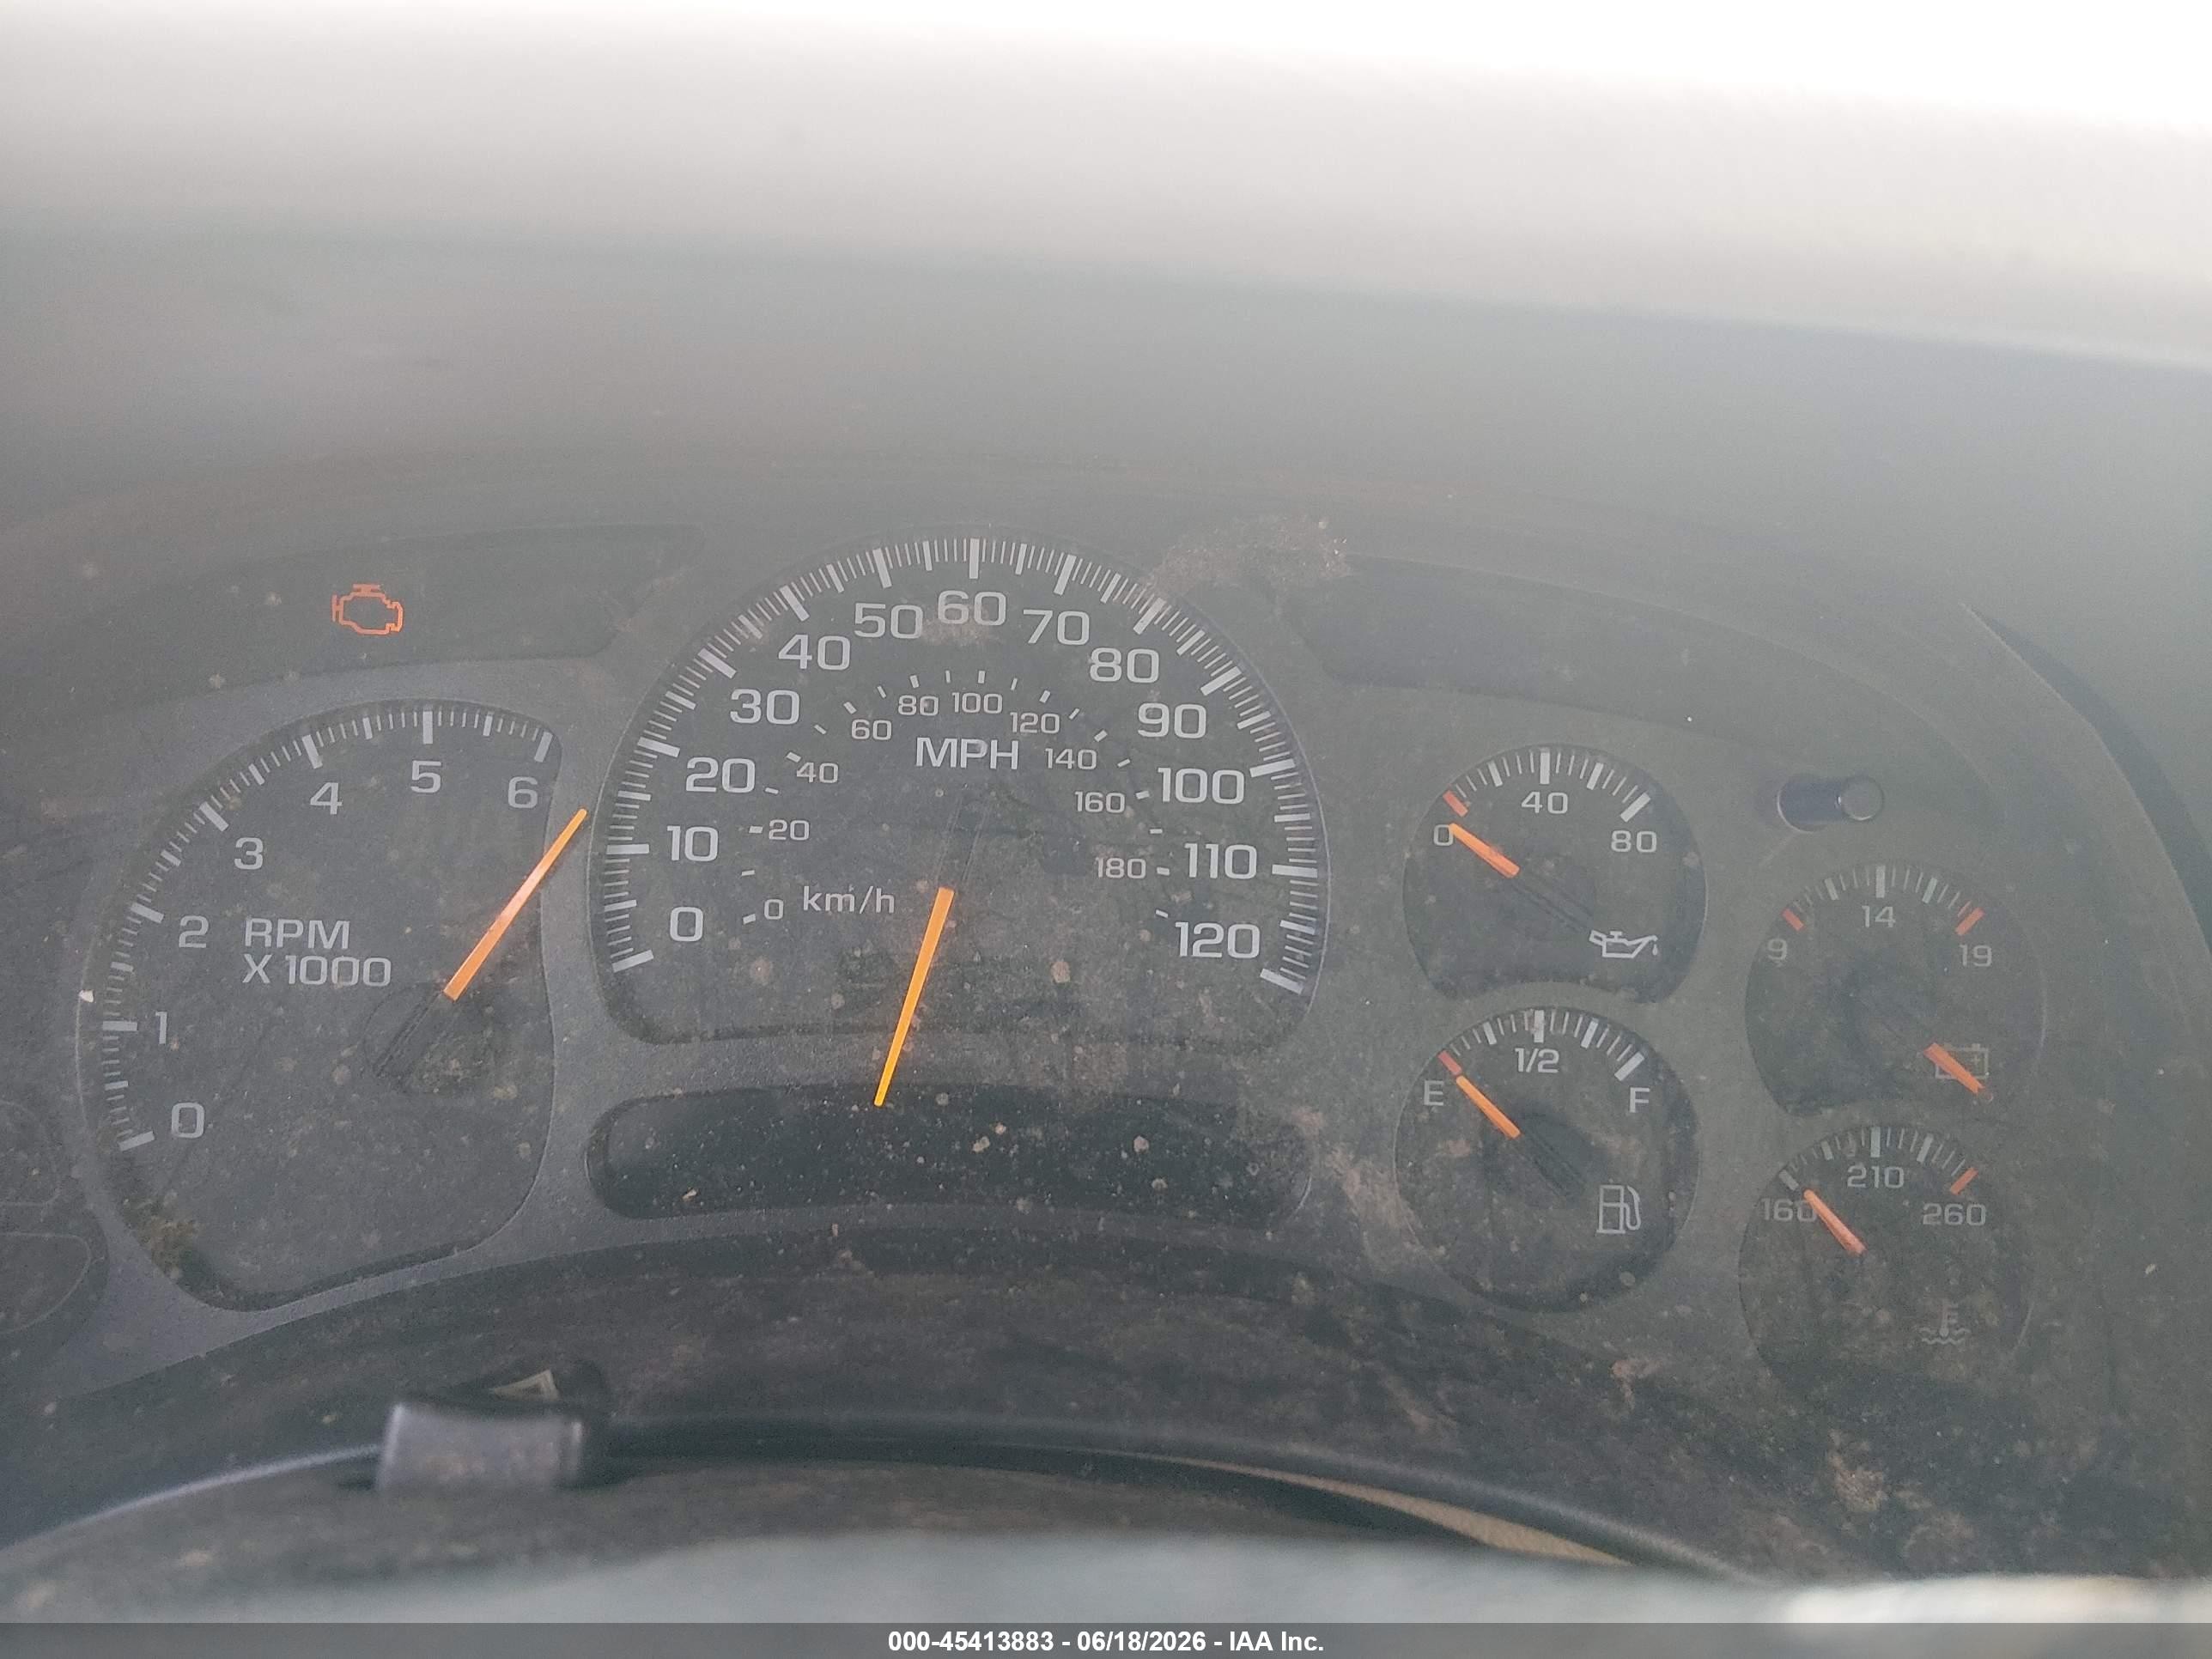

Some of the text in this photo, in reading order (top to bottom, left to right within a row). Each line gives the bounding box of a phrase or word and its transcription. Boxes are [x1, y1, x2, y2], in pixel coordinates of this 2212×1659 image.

[854, 603, 924, 639] 50
[938, 590, 1007, 626] 60
[1023, 608, 1091, 646] 70
[778, 634, 851, 671] 40
[1090, 647, 1159, 684] 80
[730, 689, 800, 725] 30
[897, 695, 939, 717] 80
[951, 692, 1003, 714] 100
[851, 719, 892, 741] 60
[1010, 712, 1060, 734] 120
[1137, 702, 1207, 739] 90
[915, 737, 1019, 769] MPH
[1046, 748, 1097, 770] 140
[410, 761, 442, 793] 5
[686, 757, 756, 793] 20
[796, 763, 840, 784] 40
[1158, 768, 1245, 805] 100
[310, 782, 343, 815] 4
[507, 776, 538, 809] 6
[1075, 791, 1126, 814] 160
[1521, 792, 1568, 814] 40
[666, 825, 720, 861] 10
[768, 819, 811, 842] 20
[1433, 823, 1454, 846] 0
[1610, 830, 1657, 854] 80
[234, 837, 264, 870] 3
[1096, 858, 1146, 879] 180
[1185, 842, 1257, 879] 110
[763, 898, 784, 921] 0
[803, 885, 896, 915] km/h
[179, 915, 209, 949] 2
[670, 906, 704, 942] 0
[1862, 905, 1896, 929] 14
[245, 919, 350, 950] RPM
[1175, 921, 1261, 959] 120
[1767, 938, 1788, 960] 9
[242, 954, 392, 987] X 1000
[1959, 945, 1993, 968] 19
[155, 1011, 168, 1045] 1
[1515, 1048, 1559, 1075] 1/2
[1424, 1080, 1444, 1107] E
[1629, 1087, 1650, 1114] F
[172, 1103, 204, 1139] 0
[1847, 1166, 1905, 1189] 210
[1760, 1198, 1817, 1222] 160
[1922, 1203, 1987, 1227] 260
